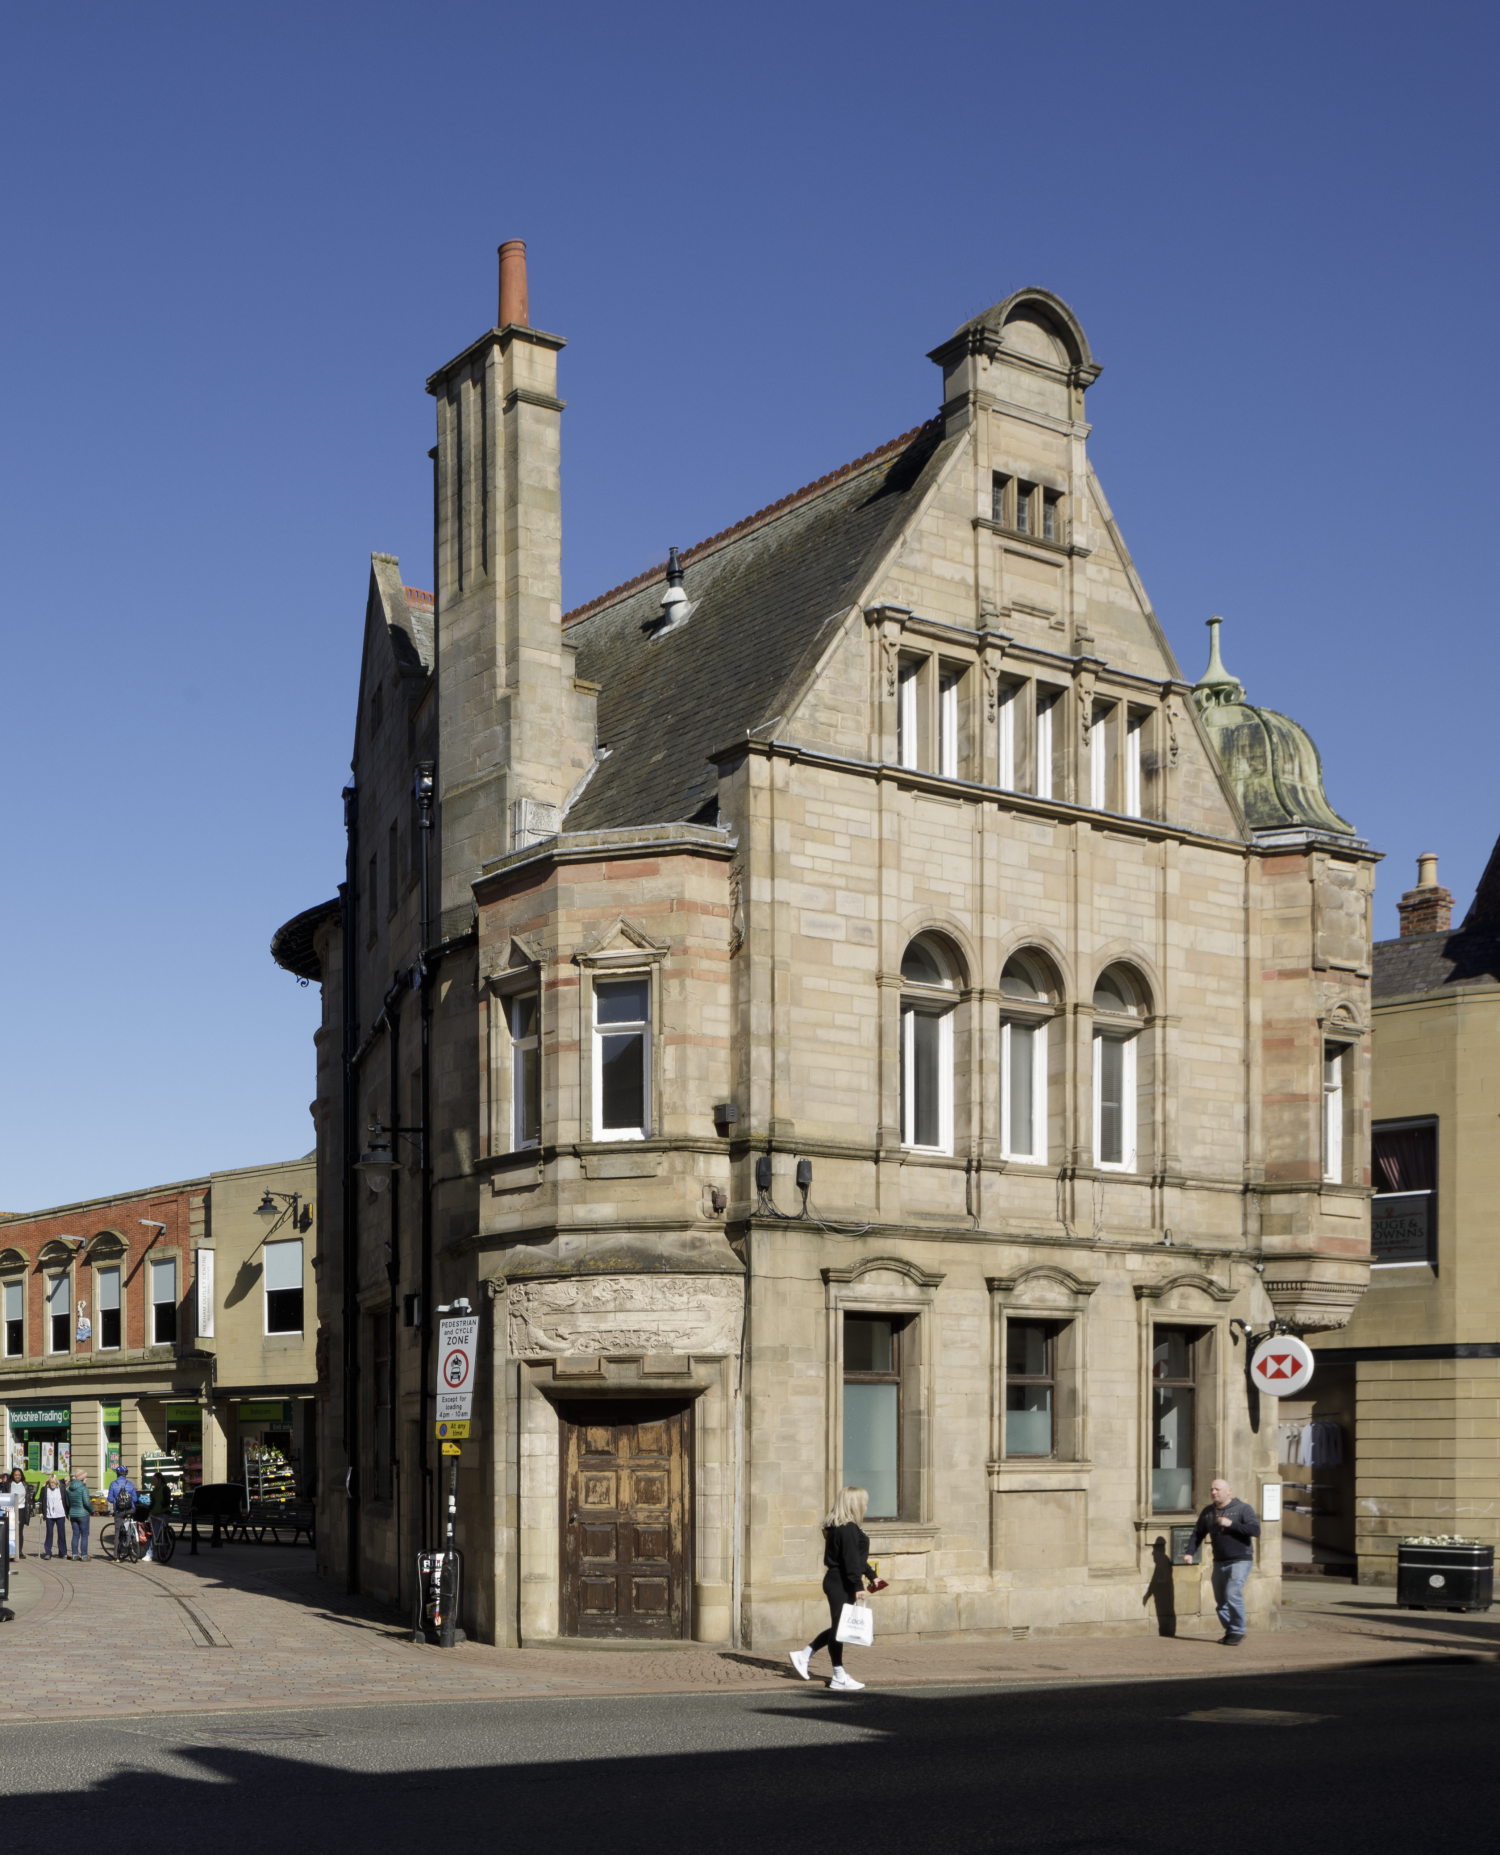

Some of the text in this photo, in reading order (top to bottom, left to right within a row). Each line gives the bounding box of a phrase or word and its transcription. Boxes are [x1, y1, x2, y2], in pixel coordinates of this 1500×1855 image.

[1371, 1218, 1418, 1231] OUGE &
[1371, 1227, 1424, 1240] OWNNS
[441, 1320, 477, 1329] PEDESTRIAN
[455, 1327, 473, 1335] CYCLE
[446, 1336, 469, 1346] ZONE
[442, 1396, 458, 1404] Except
[445, 1403, 462, 1411] loading
[250, 1408, 272, 1416] Babycare
